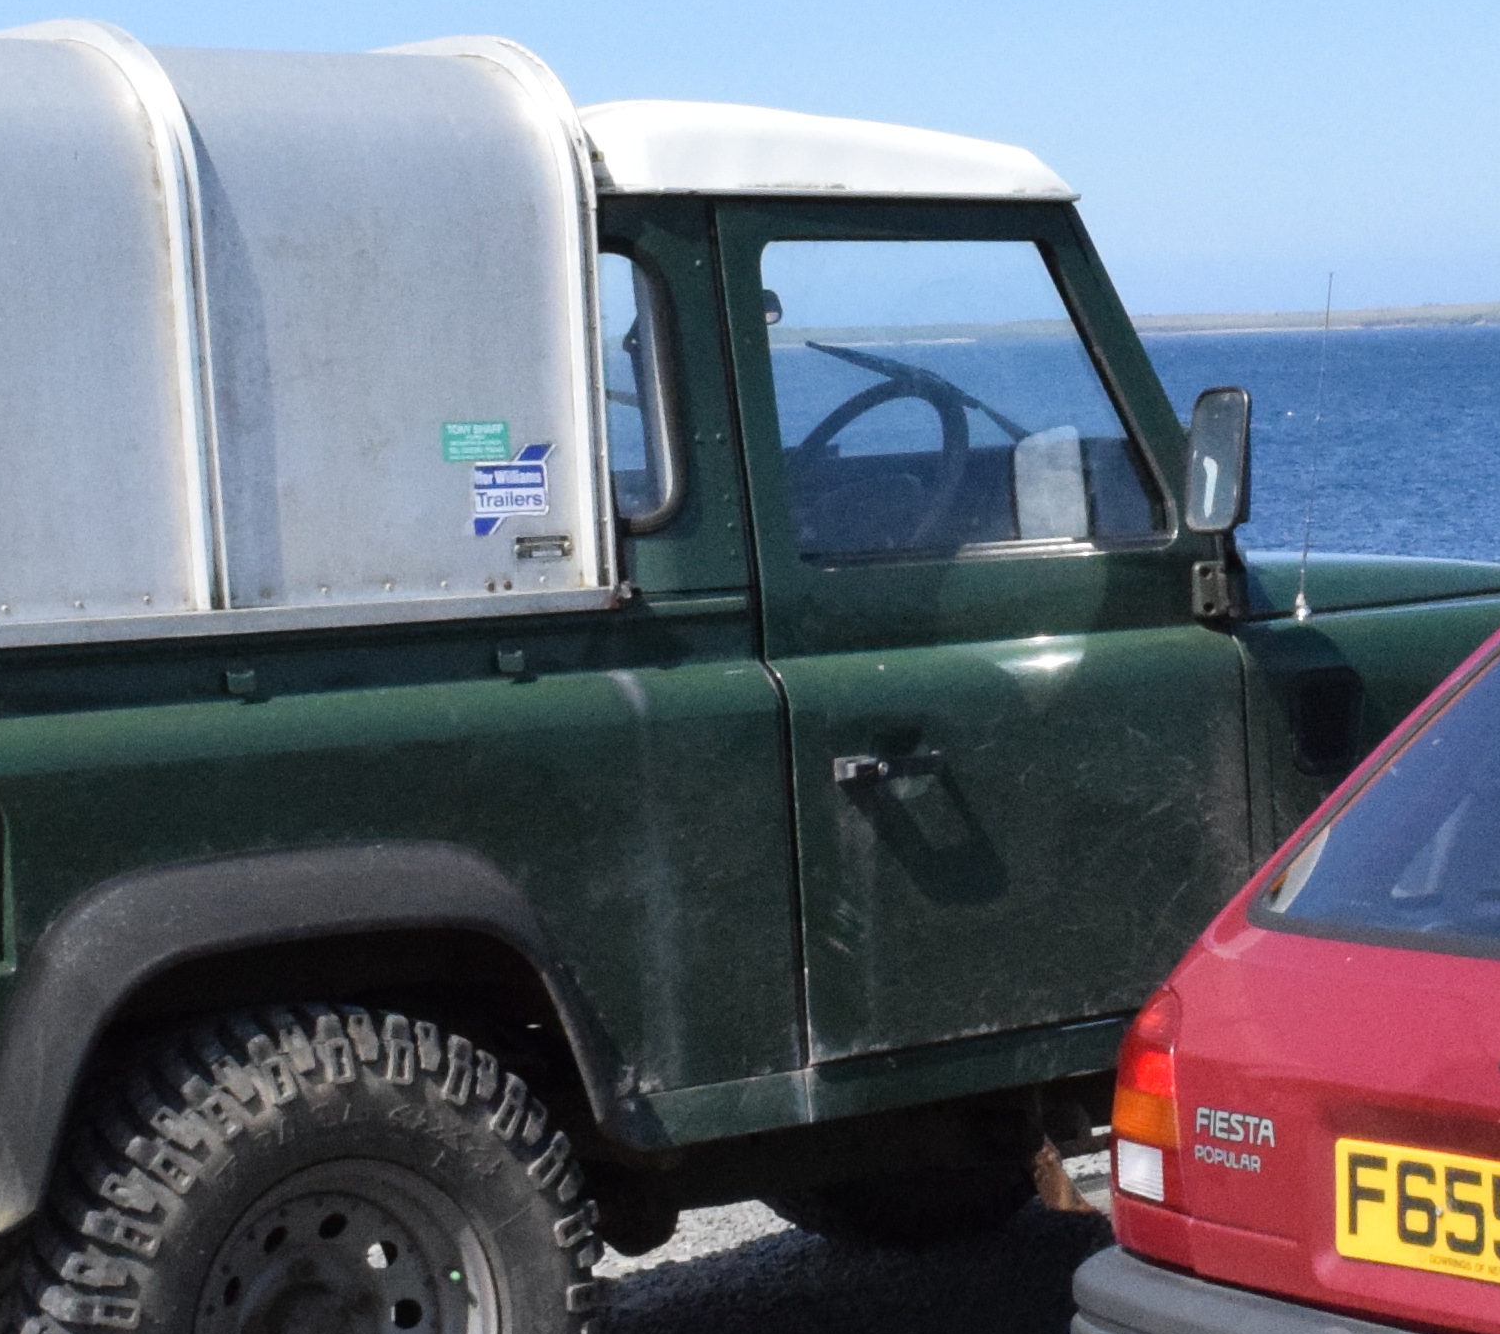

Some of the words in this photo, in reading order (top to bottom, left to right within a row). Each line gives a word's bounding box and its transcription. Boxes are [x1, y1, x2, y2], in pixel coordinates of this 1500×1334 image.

[476, 490, 543, 508] Trailers
[1196, 1107, 1275, 1147] FIESTA
[1194, 1145, 1261, 1173] POPULAR
[1475, 1262, 1486, 1273] OF
